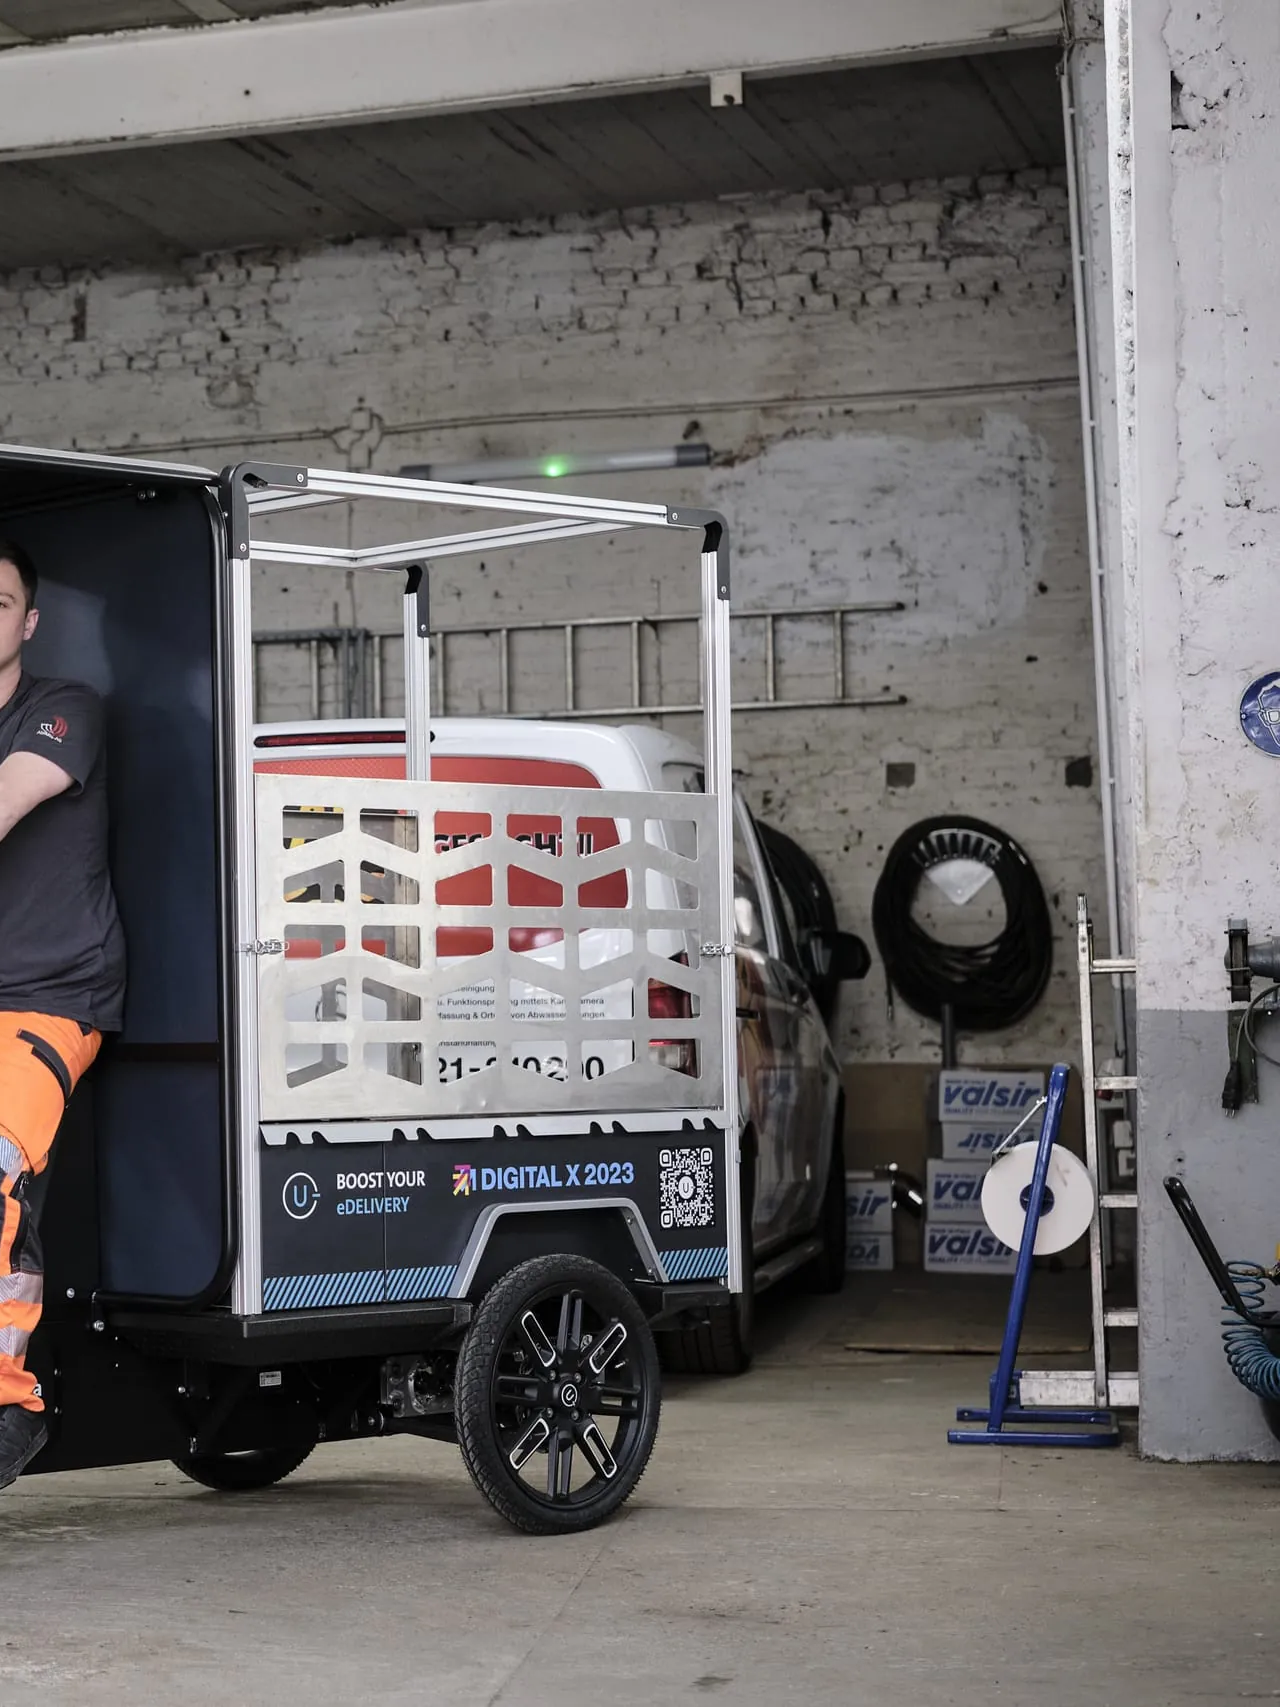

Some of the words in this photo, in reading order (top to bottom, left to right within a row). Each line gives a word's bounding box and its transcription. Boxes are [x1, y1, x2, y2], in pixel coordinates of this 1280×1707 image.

[944, 1080, 1040, 1107] valsir
[336, 1172, 384, 1190] BOOST
[386, 1170, 426, 1188] YOUR
[481, 1165, 563, 1191] DIGITAL
[565, 1164, 581, 1186] X
[584, 1162, 635, 1186] 2023
[336, 1196, 410, 1216] eDELIVERY
